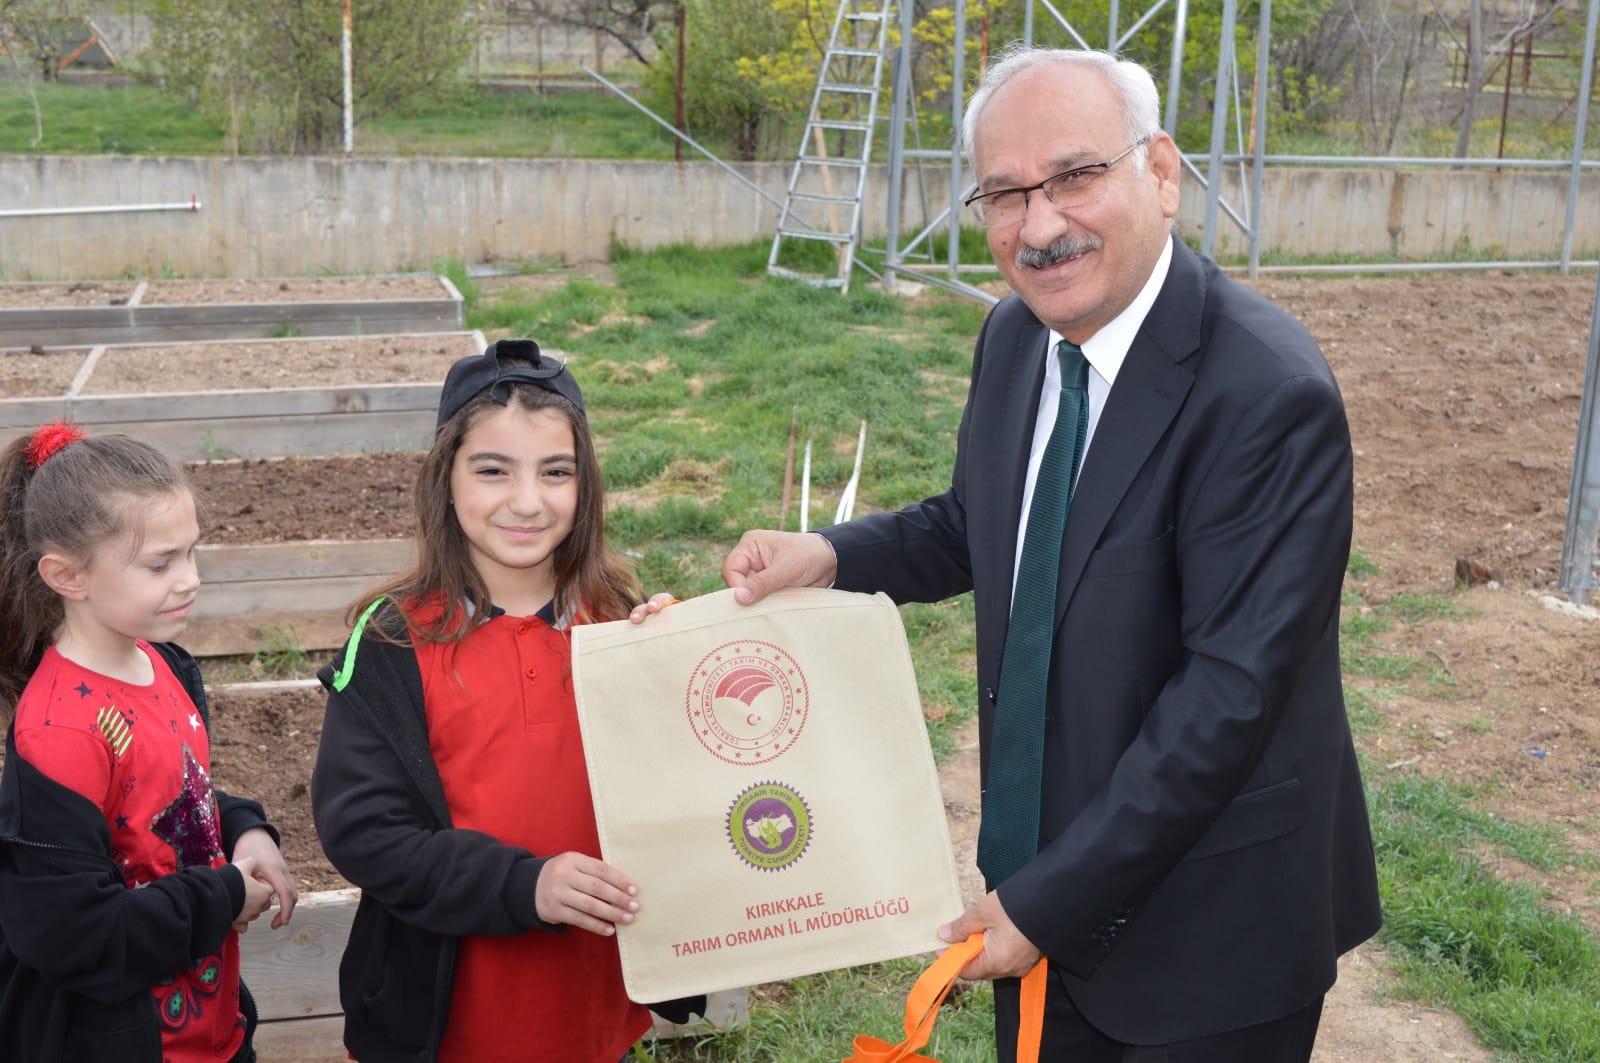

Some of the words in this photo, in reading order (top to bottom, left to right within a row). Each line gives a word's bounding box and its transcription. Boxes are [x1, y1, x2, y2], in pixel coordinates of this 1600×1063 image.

[672, 936, 722, 957] TARIM
[725, 924, 785, 947] ORMAN
[789, 918, 802, 936] İL
[806, 896, 910, 932] MÜDÜRLÜĞÜ
[746, 892, 825, 920] KIRIKKALE
